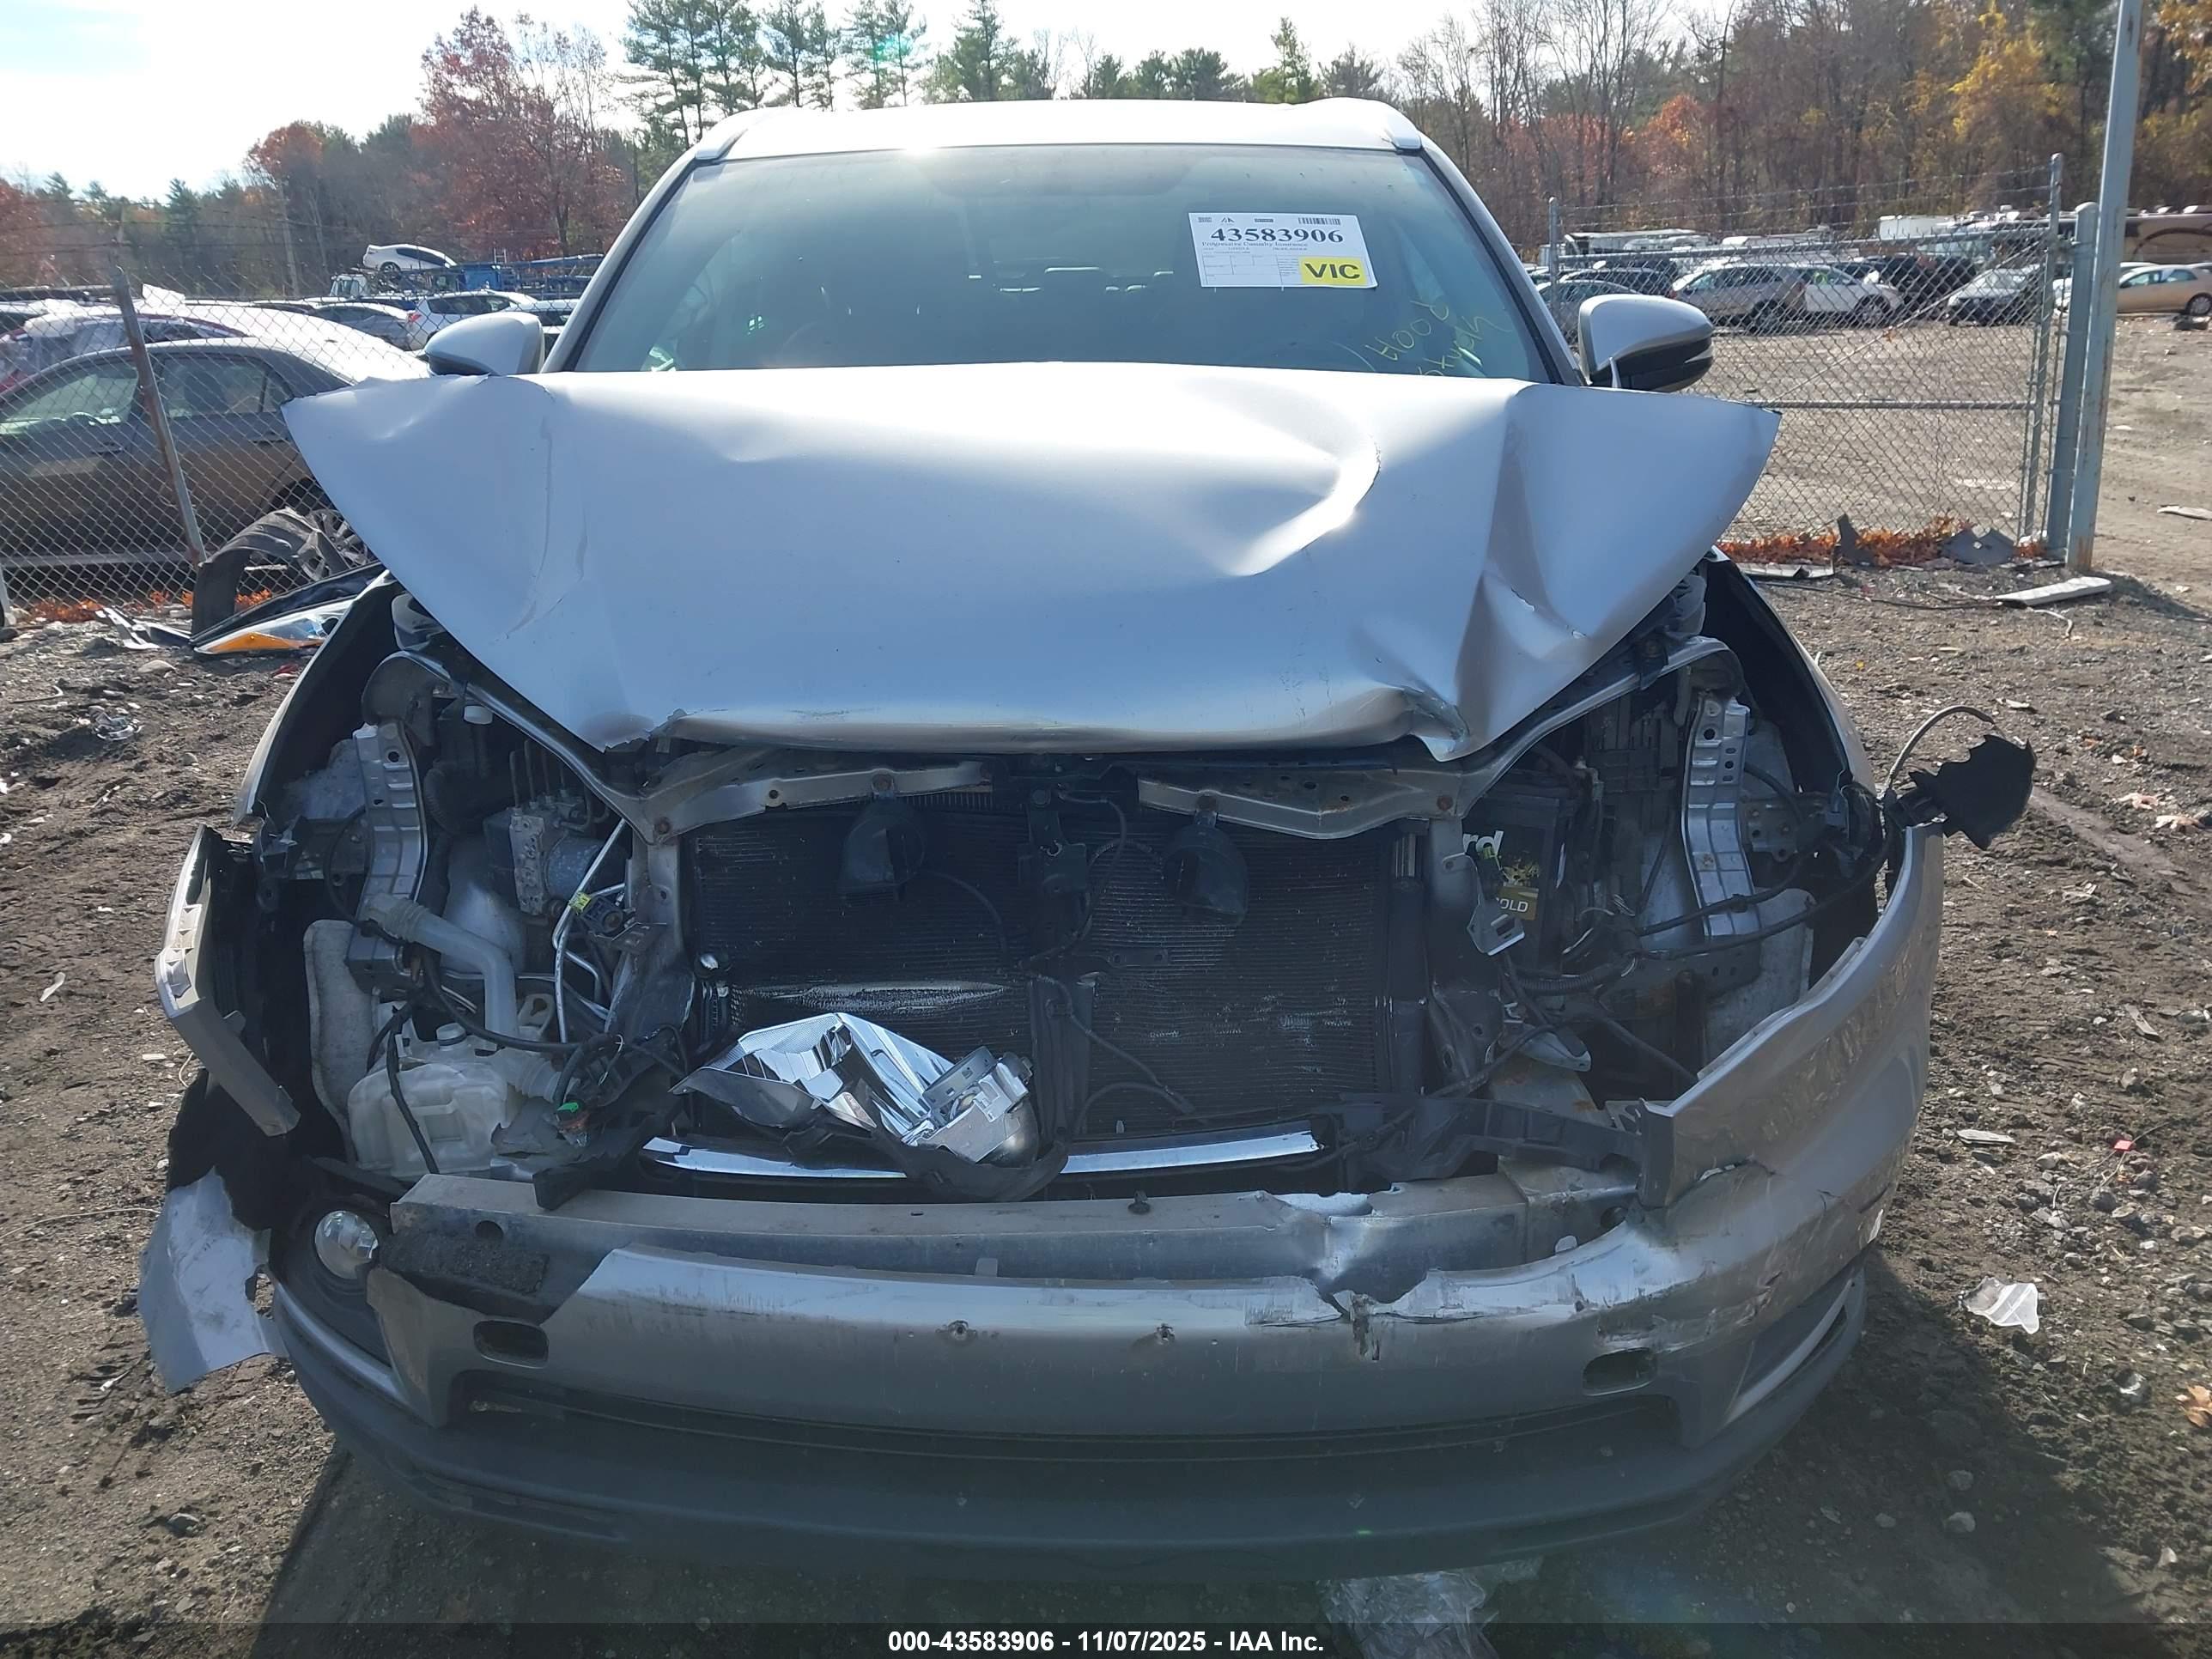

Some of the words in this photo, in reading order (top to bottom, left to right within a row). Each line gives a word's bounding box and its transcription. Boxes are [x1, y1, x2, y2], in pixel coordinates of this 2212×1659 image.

[1211, 227, 1344, 243] 43583906
[1304, 263, 1361, 280] VIC
[1495, 896, 1528, 913] OLD
